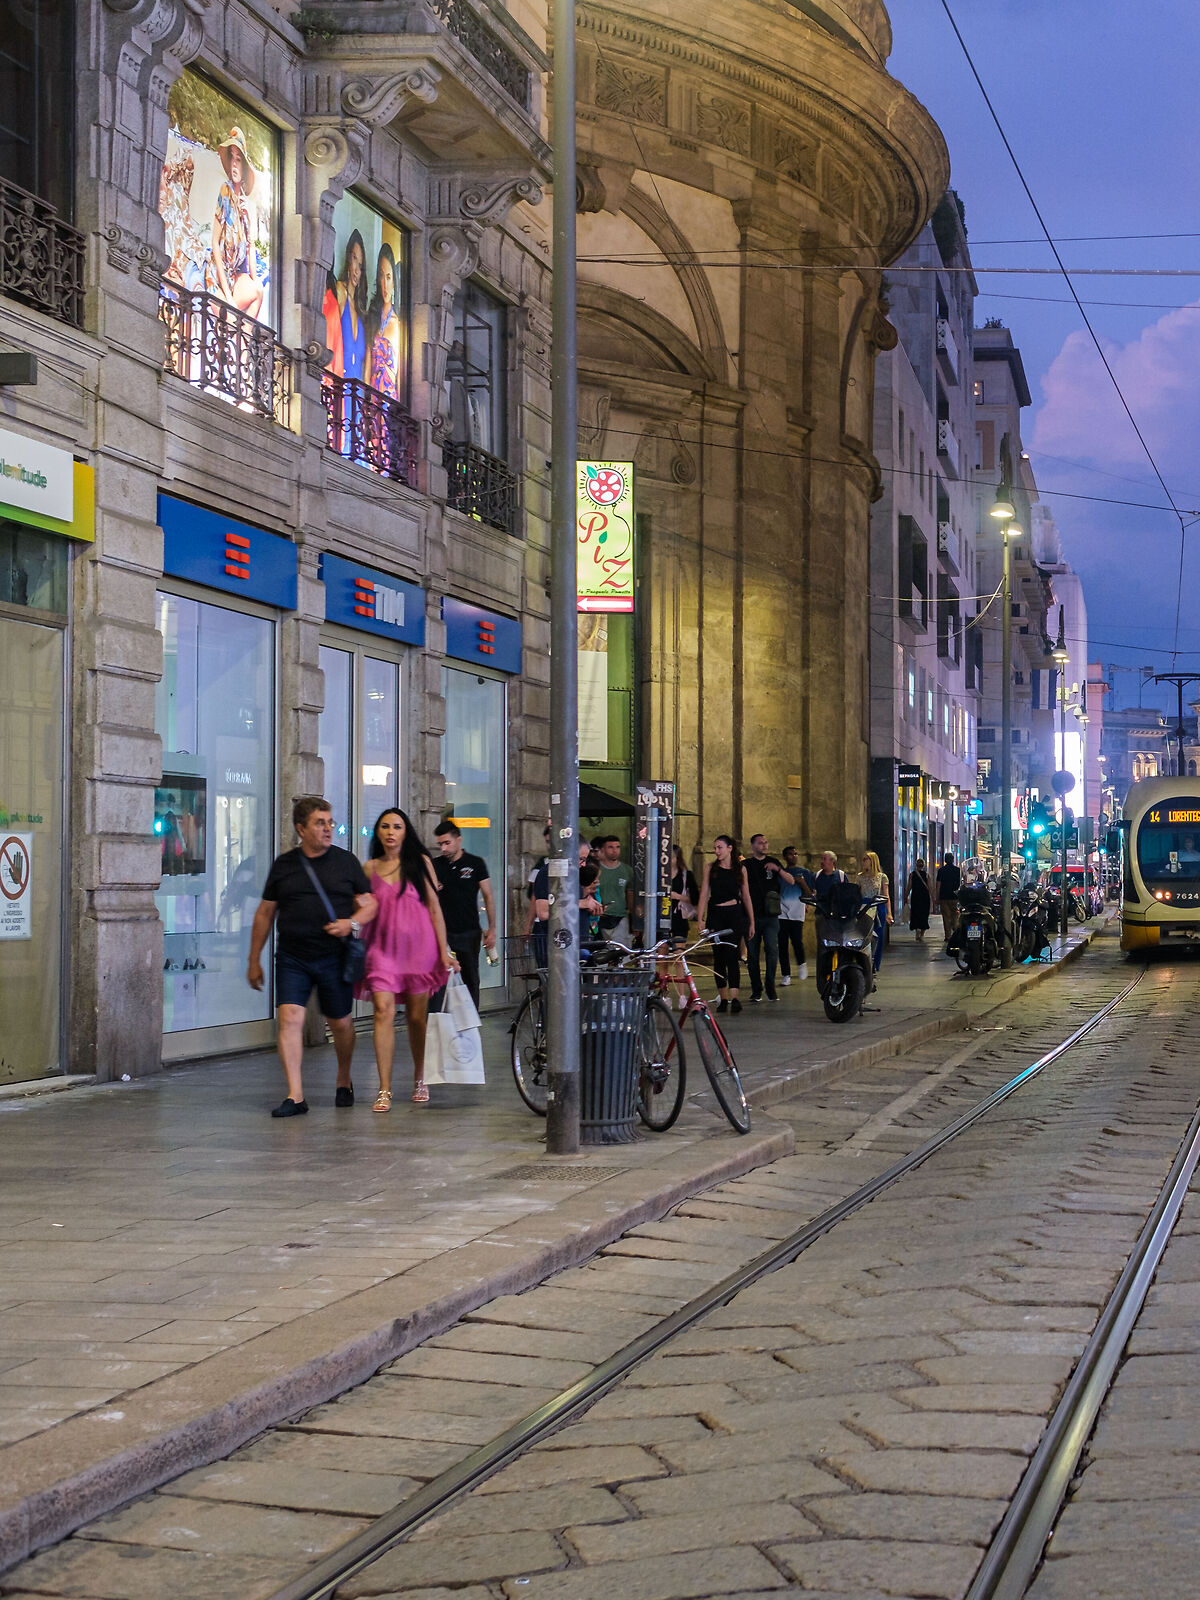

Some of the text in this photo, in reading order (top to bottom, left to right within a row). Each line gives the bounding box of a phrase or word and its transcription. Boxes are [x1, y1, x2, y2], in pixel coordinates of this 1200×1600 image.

[0, 458, 47, 488] lenitude
[374, 583, 405, 627] TIM
[656, 784, 674, 793] FHS
[1150, 811, 1161, 823] 14
